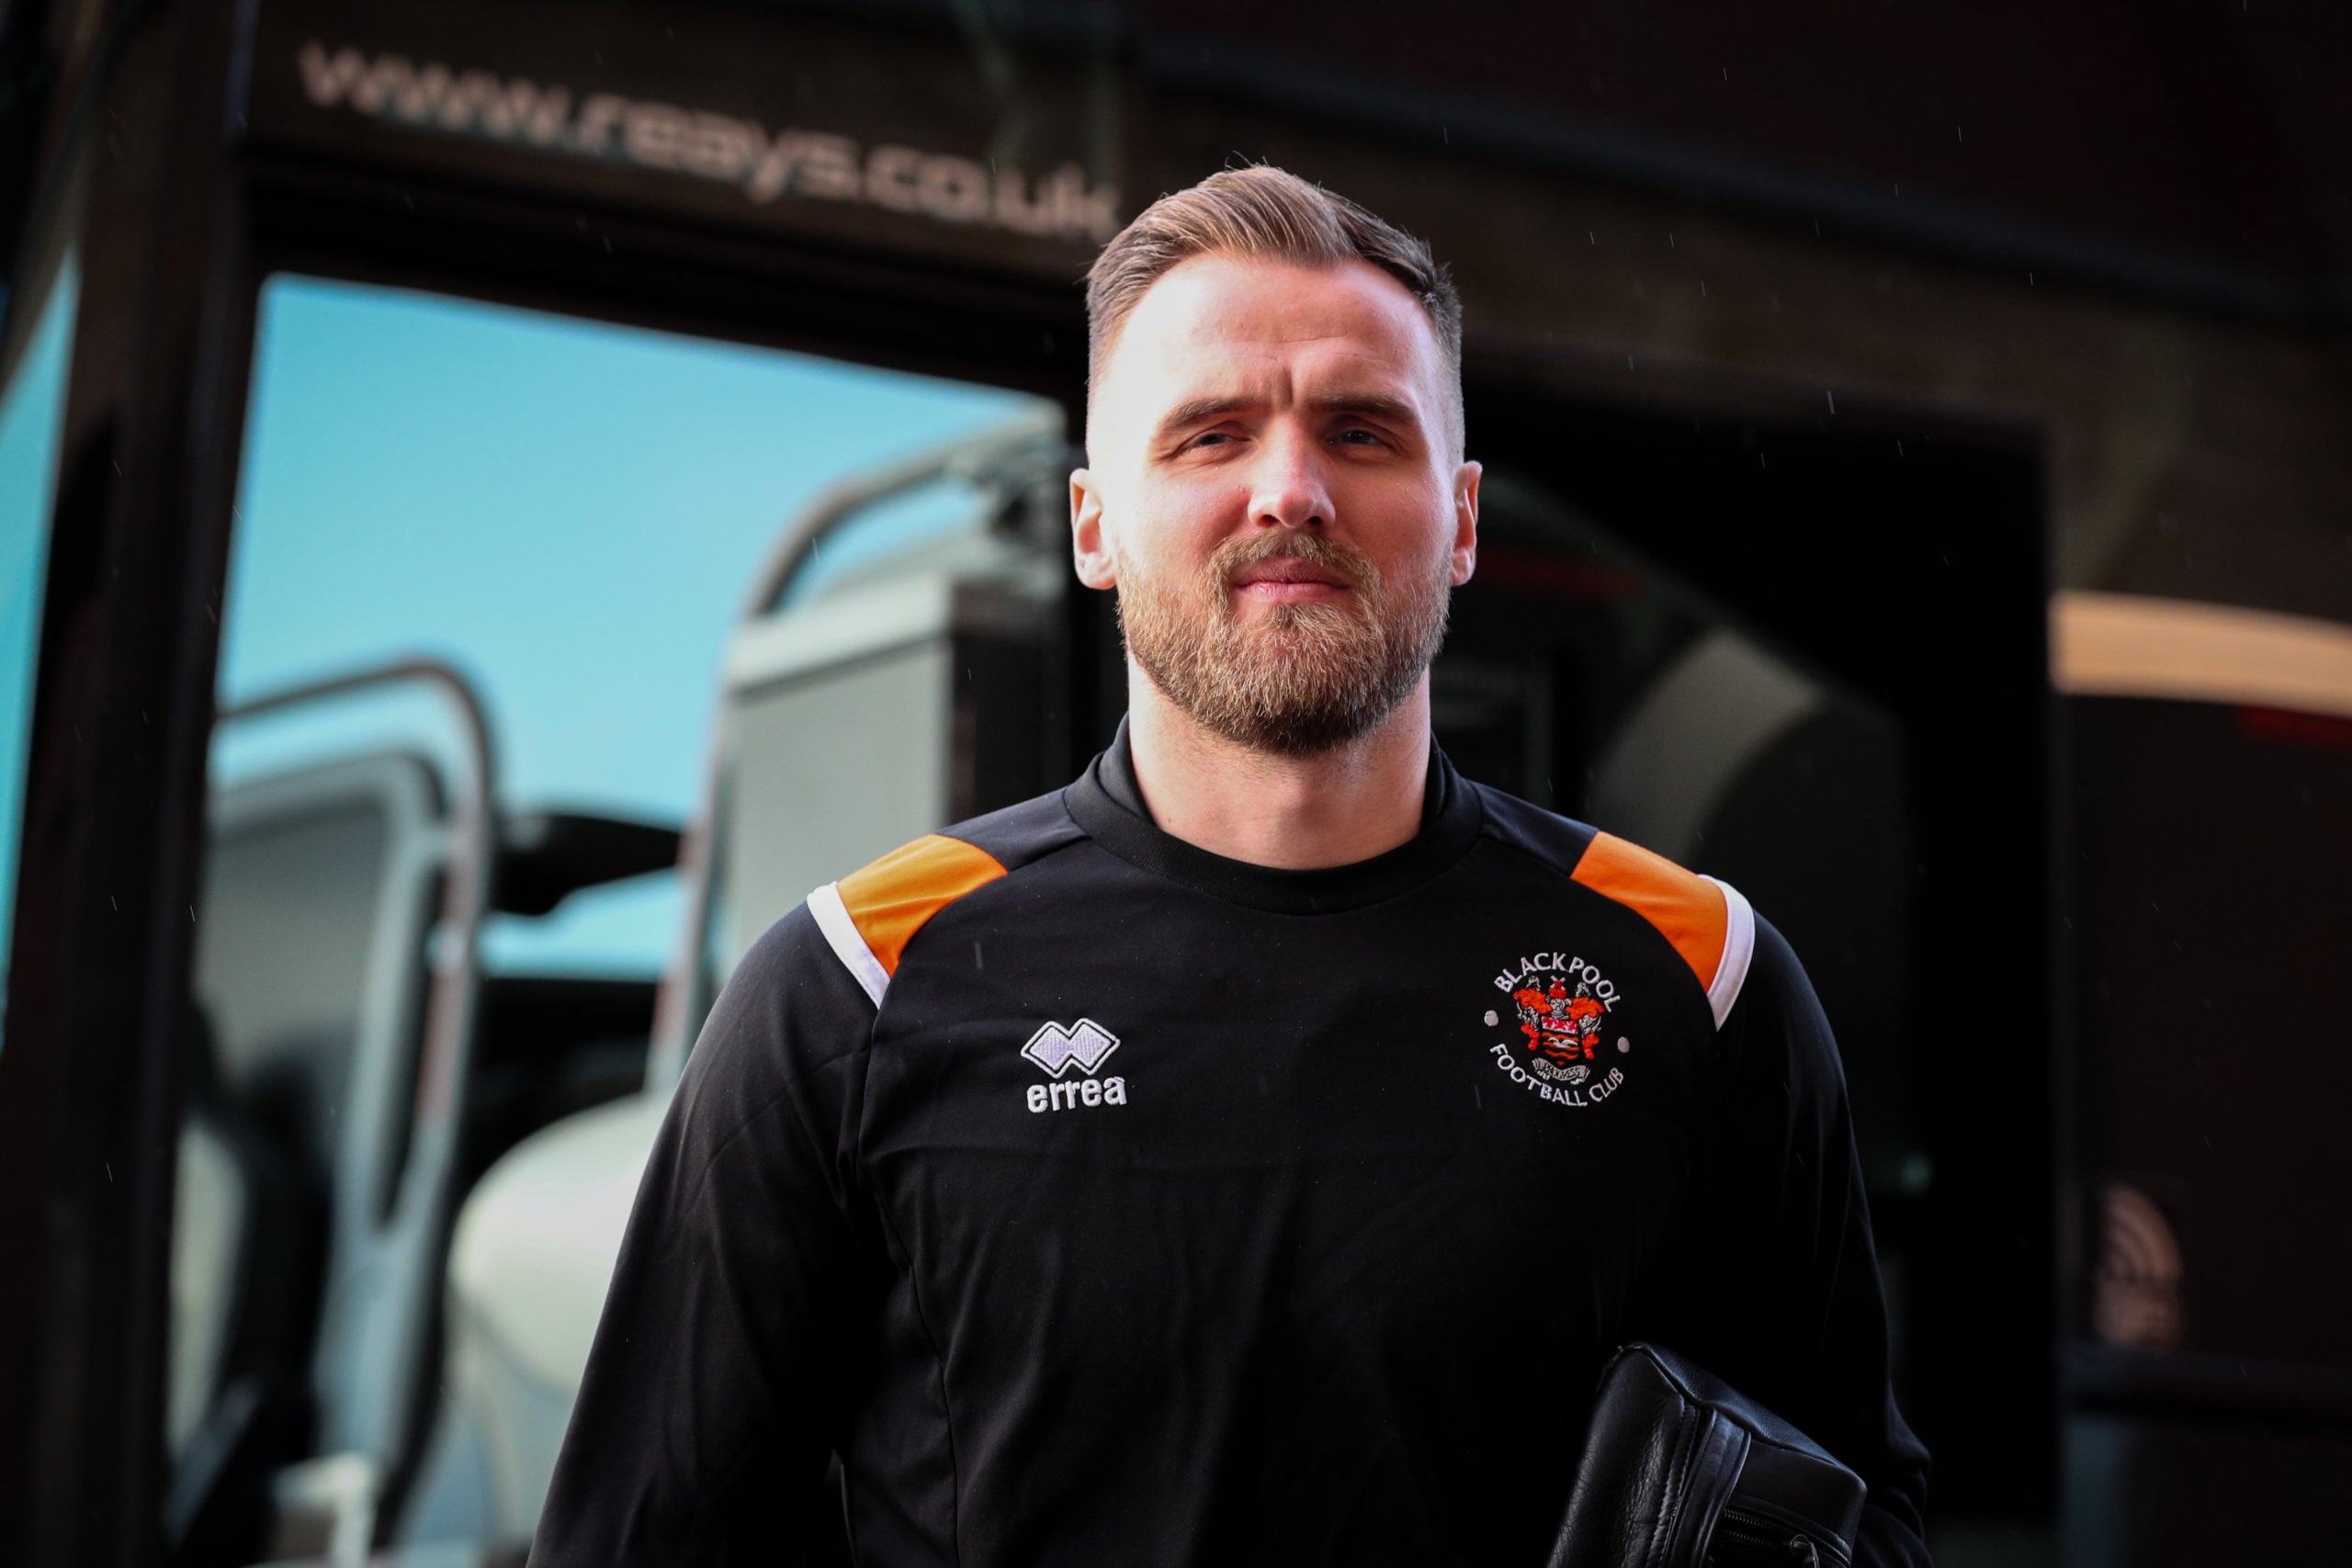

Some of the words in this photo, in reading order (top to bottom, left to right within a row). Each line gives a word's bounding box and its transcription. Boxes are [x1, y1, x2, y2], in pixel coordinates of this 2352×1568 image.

[1494, 952, 1621, 1012] BLACKPOOL
[1489, 1043, 1589, 1107] FOOTBALL
[1589, 1066, 1624, 1102] CLUB
